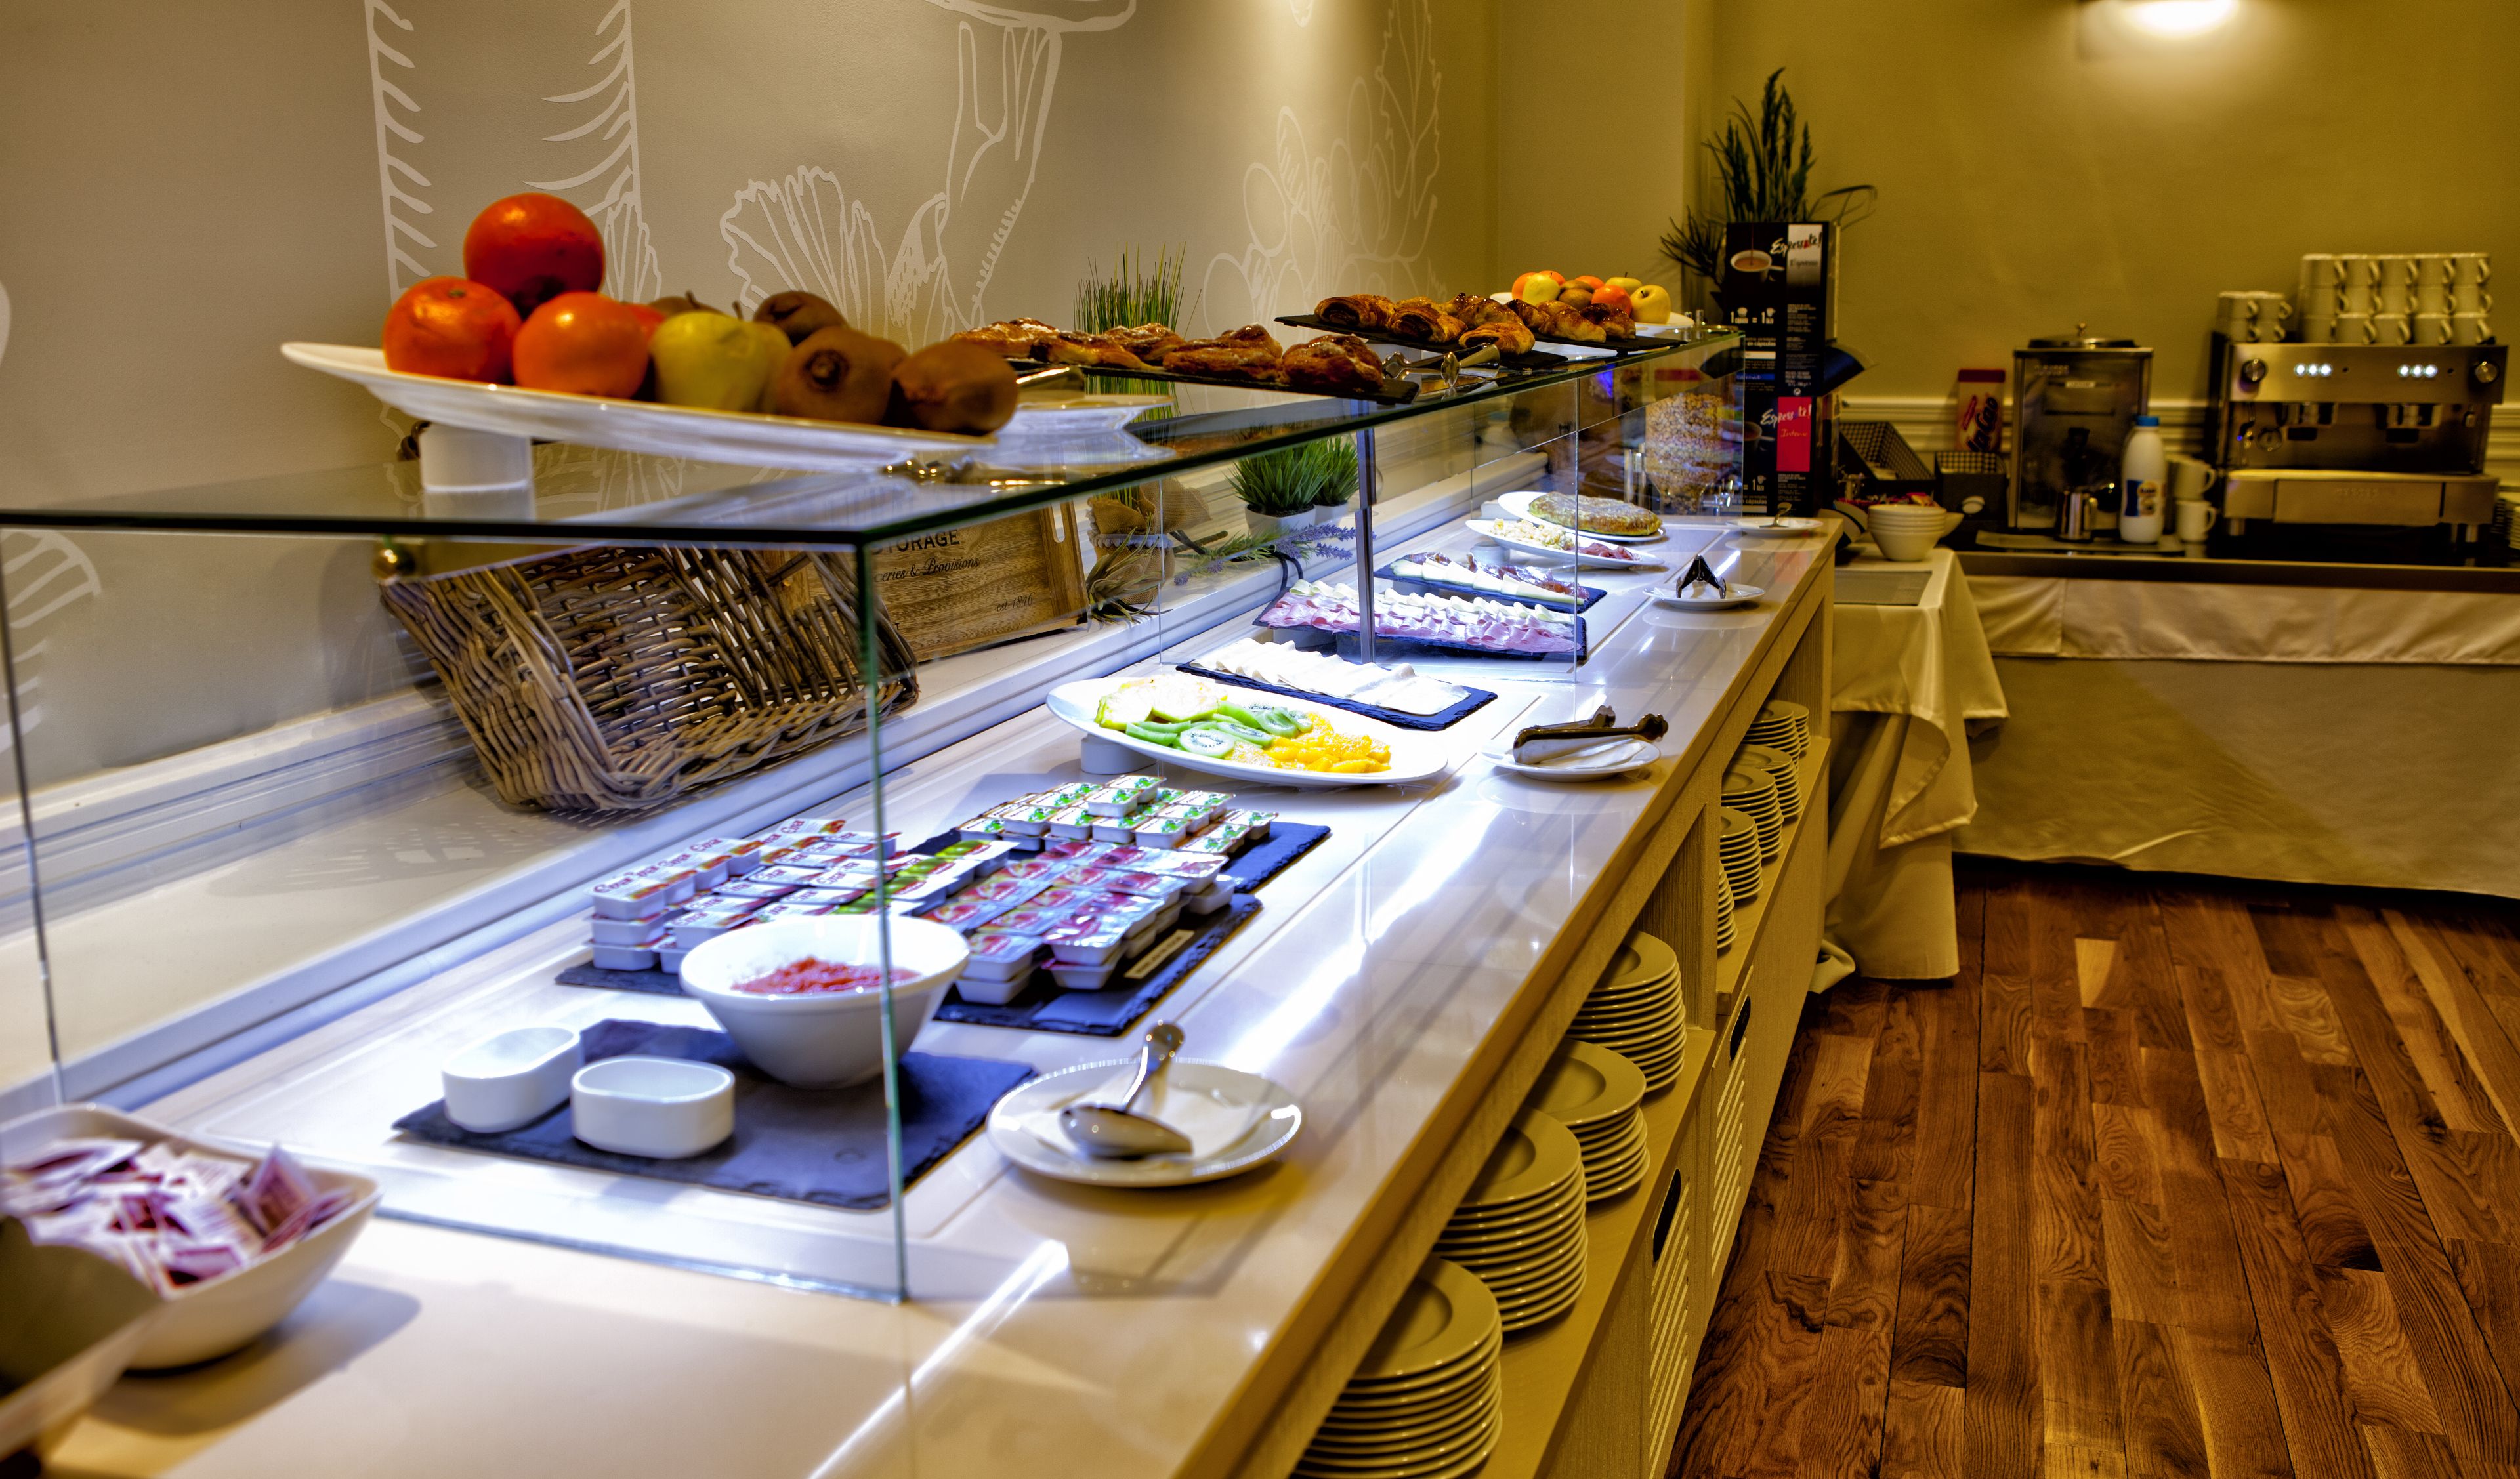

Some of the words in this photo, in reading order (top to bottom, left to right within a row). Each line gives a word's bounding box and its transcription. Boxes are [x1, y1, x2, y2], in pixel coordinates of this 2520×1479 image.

[910, 564, 920, 577] &
[921, 557, 982, 575] Provisions
[996, 600, 1009, 612] est
